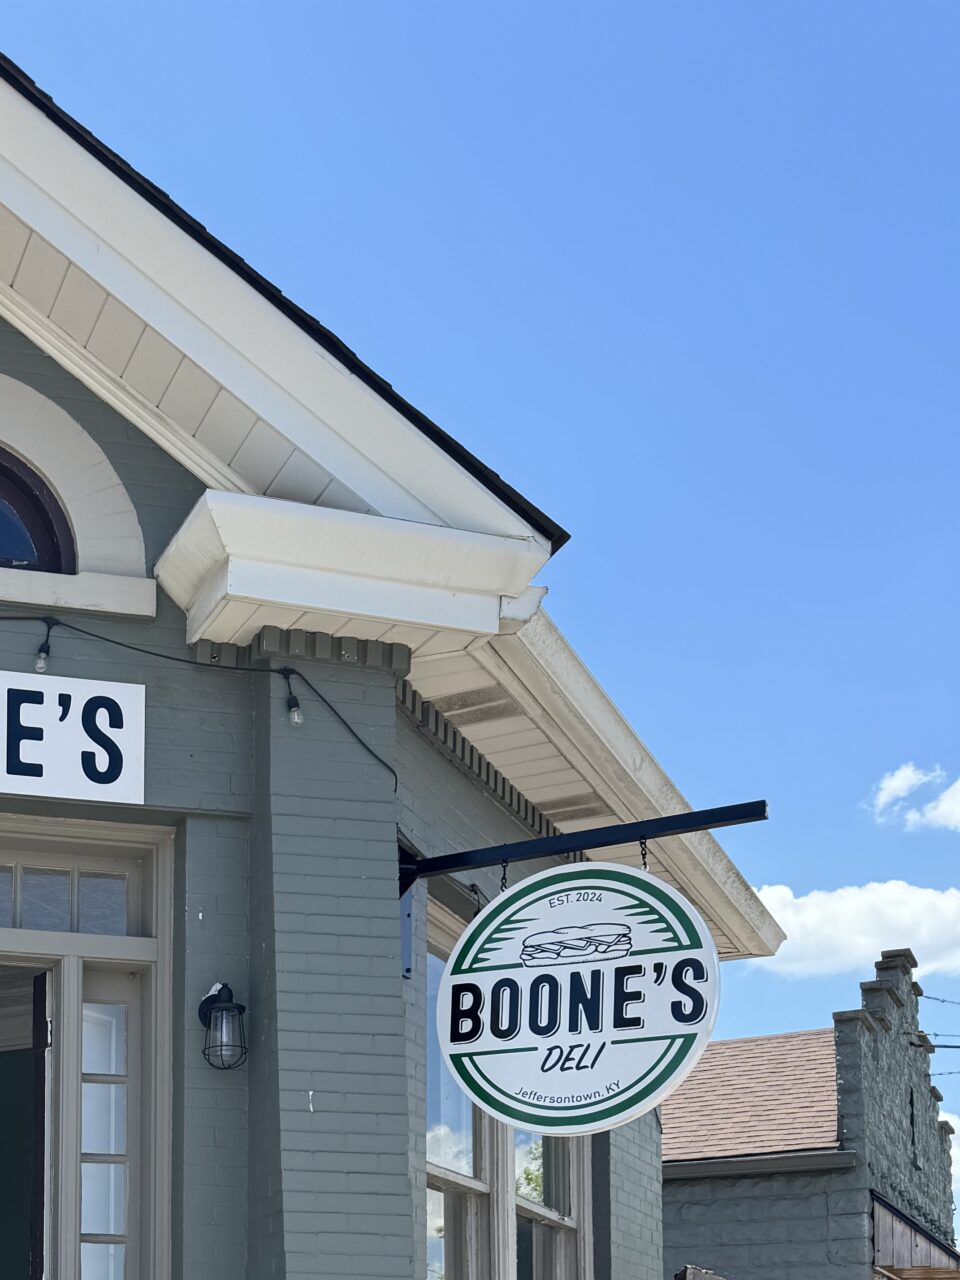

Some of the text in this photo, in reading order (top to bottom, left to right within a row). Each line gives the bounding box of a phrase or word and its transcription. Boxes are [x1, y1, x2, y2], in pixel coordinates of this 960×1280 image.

[548, 891, 603, 909] EST. 2024
[449, 957, 708, 1045] BOONE'S
[540, 1041, 606, 1073] DELI
[605, 1079, 621, 1094] KY
